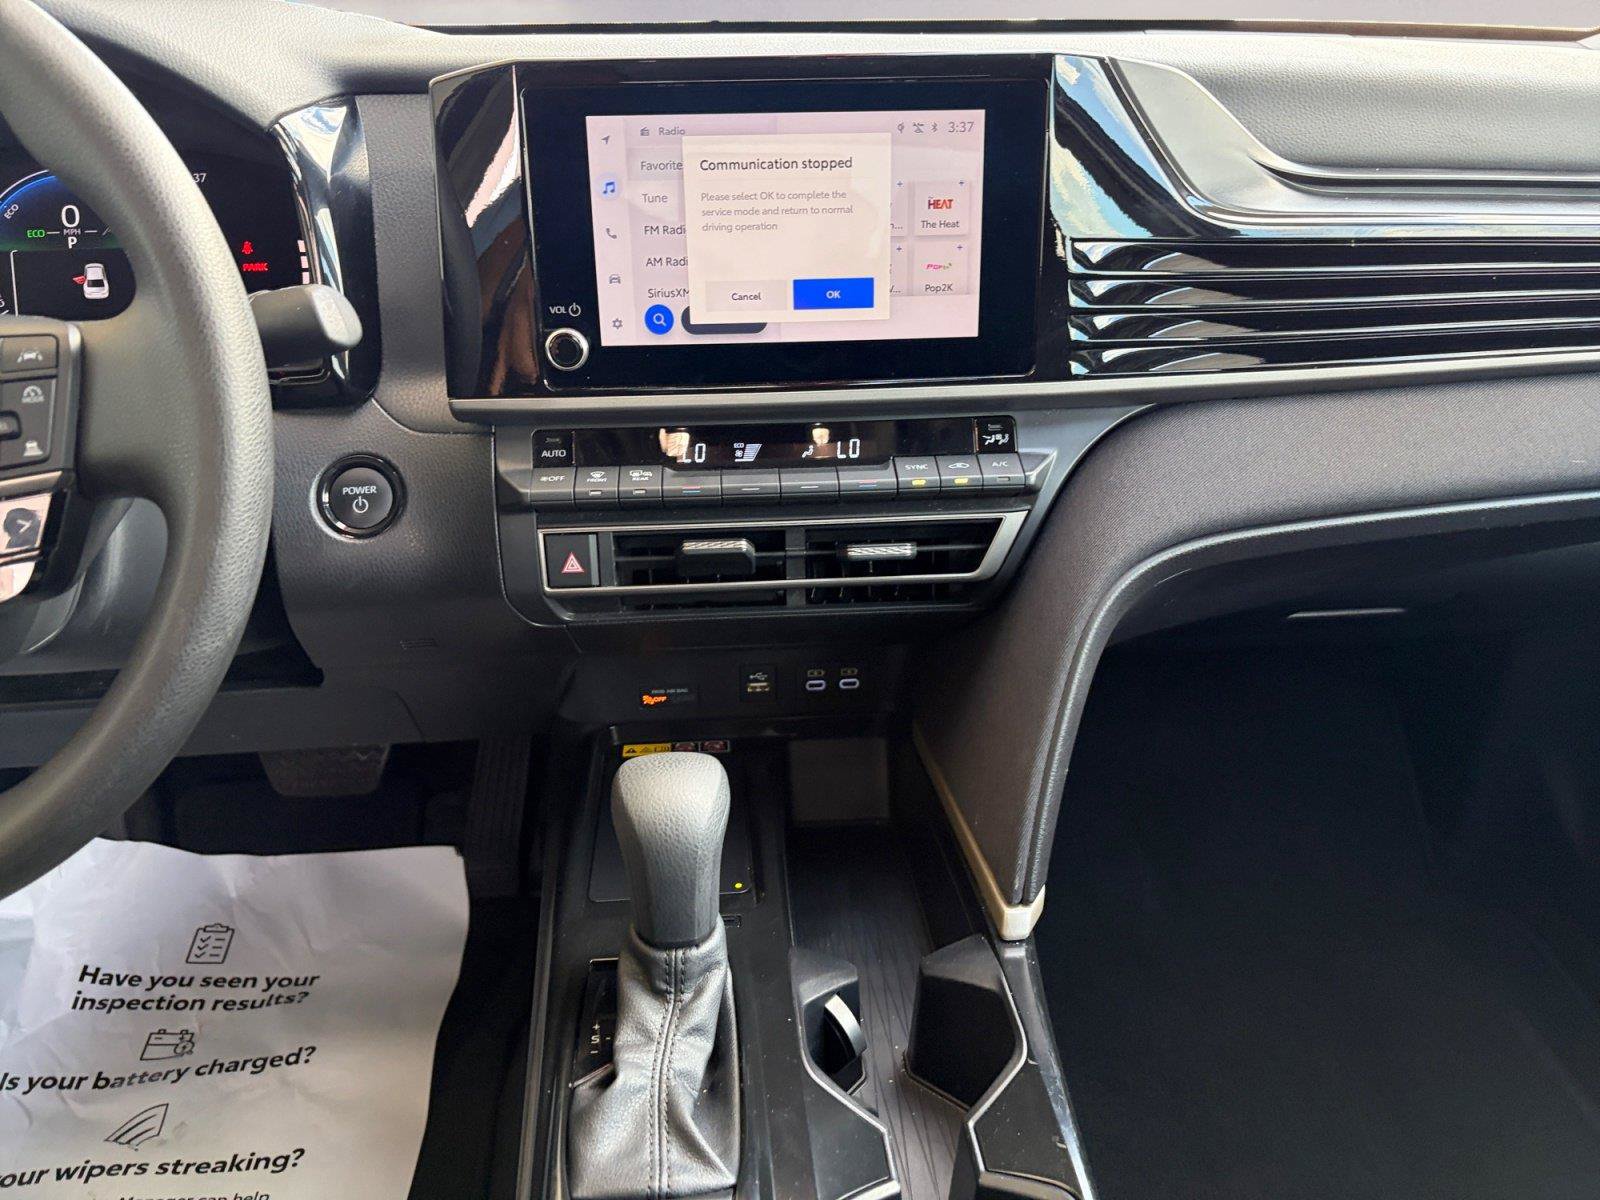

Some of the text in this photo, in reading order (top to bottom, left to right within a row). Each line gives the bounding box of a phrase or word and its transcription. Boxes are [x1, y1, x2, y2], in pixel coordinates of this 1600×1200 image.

[658, 126, 686, 136] Radio
[947, 121, 975, 133] 3:37
[640, 160, 683, 171] Favorite
[699, 156, 853, 172] Communication stopped
[192, 173, 207, 183] 37
[641, 193, 668, 203] Tune
[701, 189, 847, 202] Please select OK to complete the
[927, 199, 954, 209] HEAT
[4, 204, 19, 219] ECO
[701, 204, 854, 216] service mode and return to normal
[702, 222, 778, 233] driving operation
[921, 220, 960, 229] The Heat
[26, 229, 46, 238] ECO
[63, 228, 81, 236] MPH
[644, 225, 686, 235] FM Radi
[67, 236, 78, 249] P
[646, 256, 689, 267] AM Radi
[924, 284, 953, 294] Pop2K
[731, 291, 762, 301] Cancel
[826, 290, 841, 299] OK
[549, 305, 567, 314] VOL
[541, 449, 566, 458] AUTO
[904, 463, 928, 471] SYNC
[991, 460, 1009, 468] A/C
[342, 485, 377, 496] POWER
[78, 965, 320, 992] Have you seen your
[71, 991, 310, 1013] inspection results?
[591, 1034, 600, 1044] S
[22, 1075, 87, 1095] your
[91, 1066, 191, 1090] battery
[194, 1045, 317, 1077] charged?
[0, 1147, 305, 1188] our wipers streaking?
